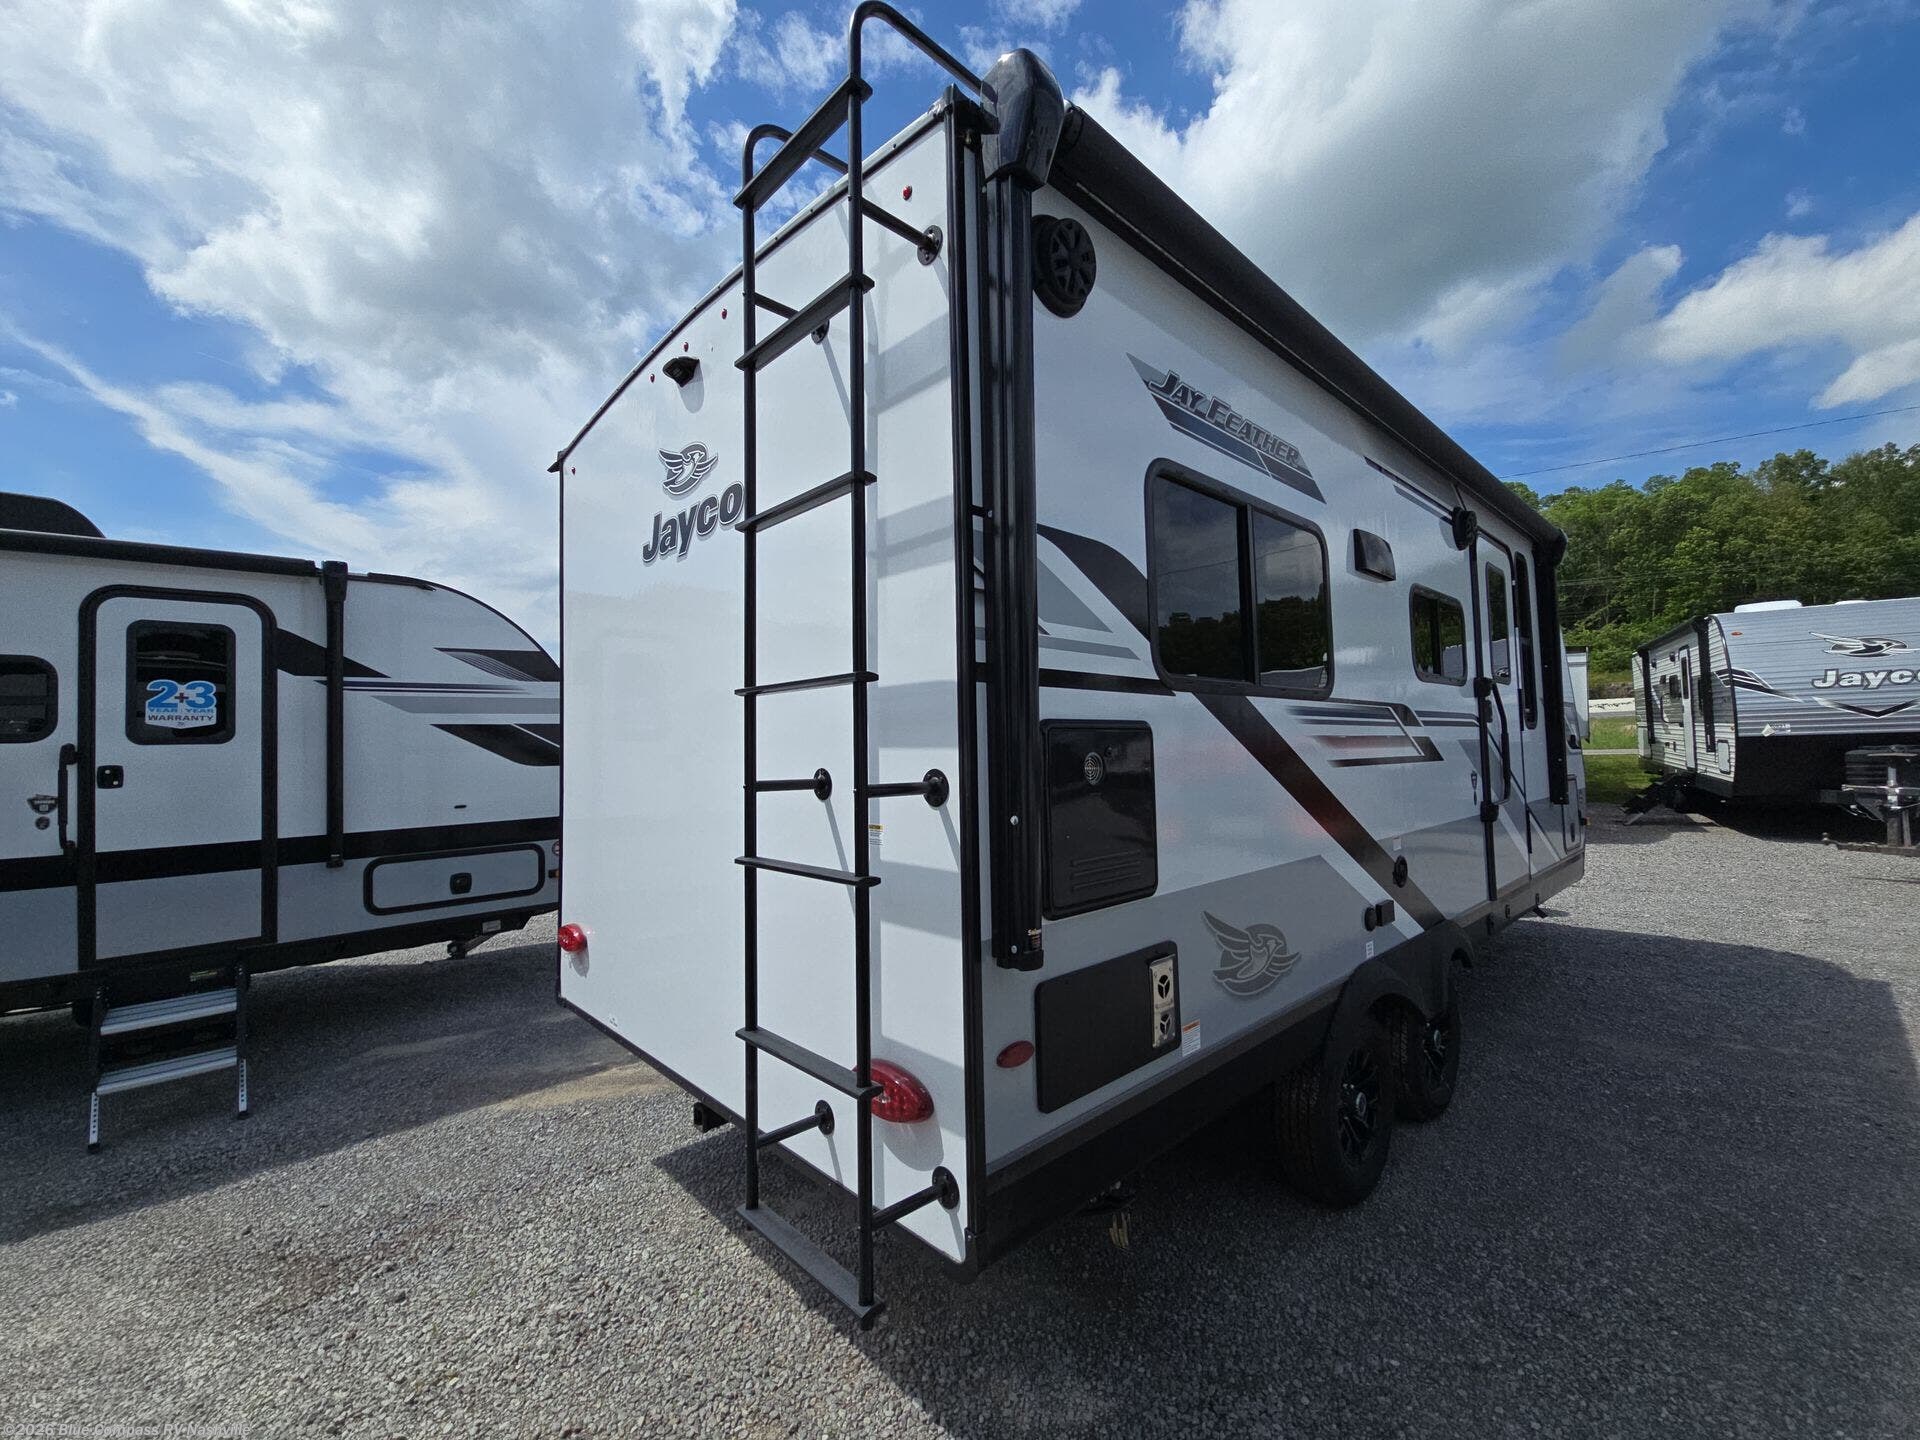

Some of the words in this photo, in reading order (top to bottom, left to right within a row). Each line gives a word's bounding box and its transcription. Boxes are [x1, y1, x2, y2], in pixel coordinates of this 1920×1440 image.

[1149, 370, 1206, 412] JAY
[1205, 397, 1300, 468] FEATHER
[642, 481, 744, 563] Jayco
[1811, 669, 1920, 690] Jayc
